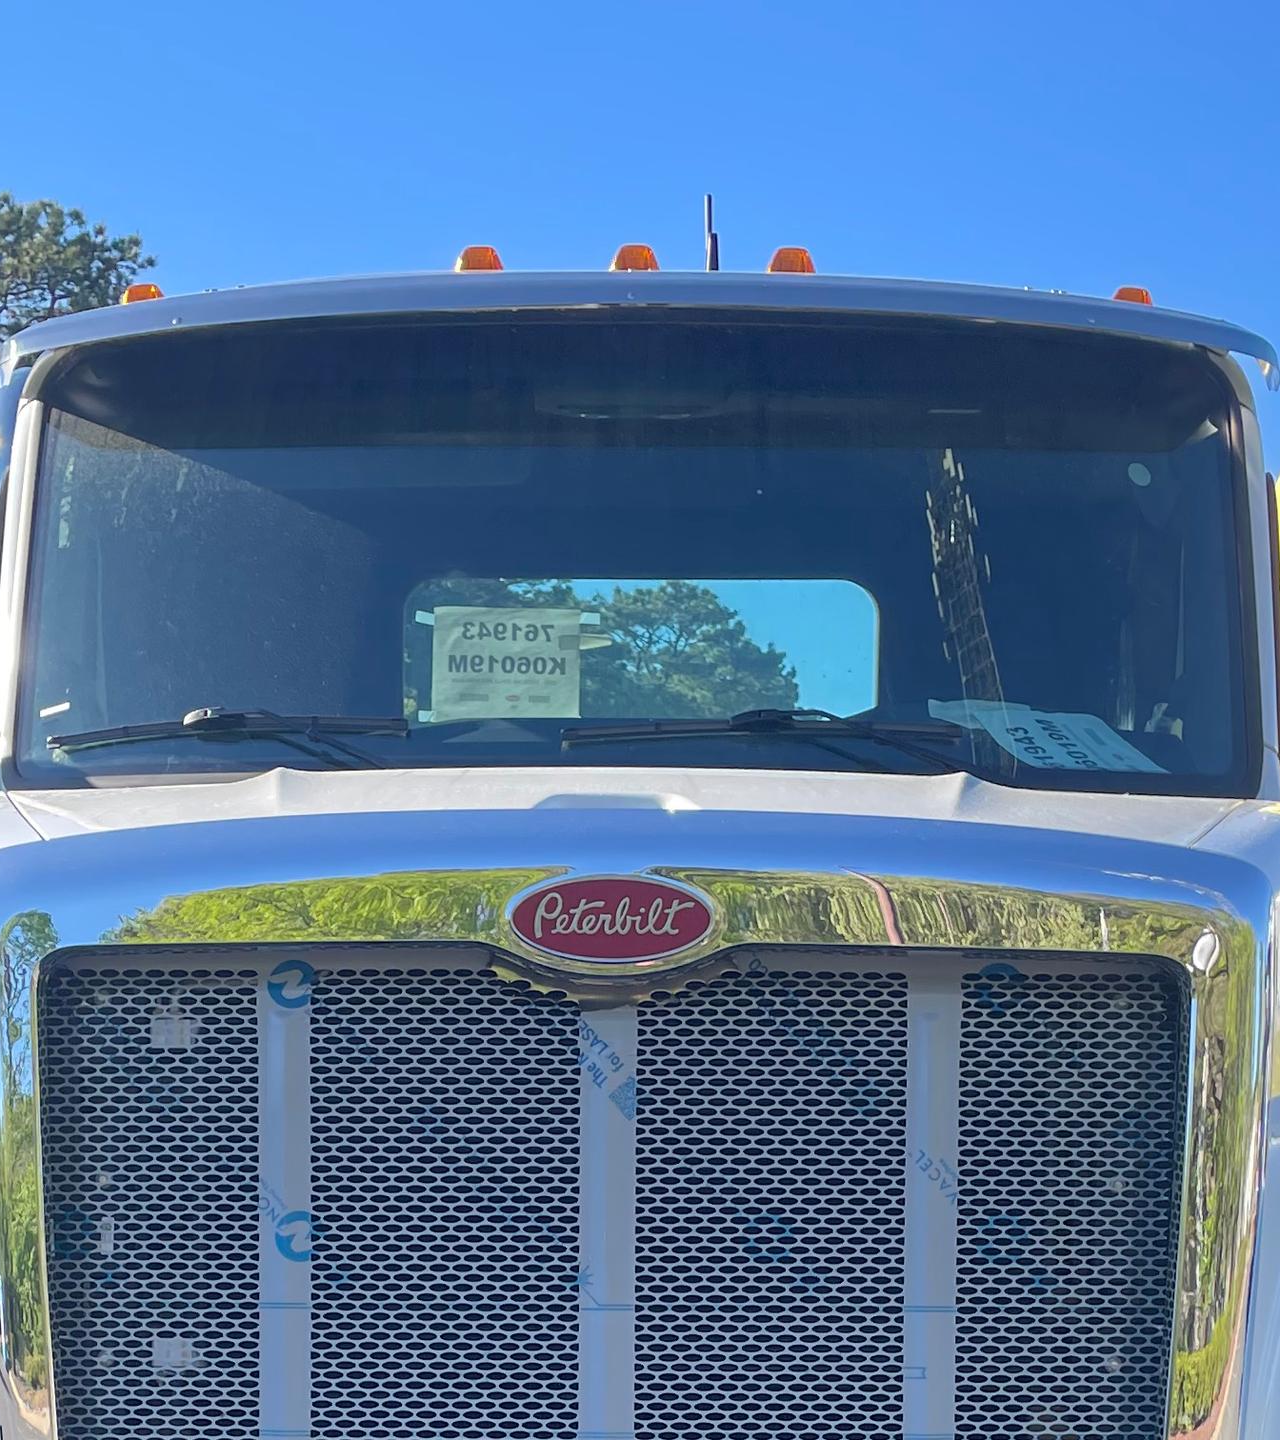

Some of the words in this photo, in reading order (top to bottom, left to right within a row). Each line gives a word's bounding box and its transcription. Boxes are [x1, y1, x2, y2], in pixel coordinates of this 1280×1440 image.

[1006, 726, 1065, 768] 1943
[533, 891, 695, 939] Peterbilt
[579, 1019, 609, 1056] LASE
[915, 1149, 958, 1205] VACEL
